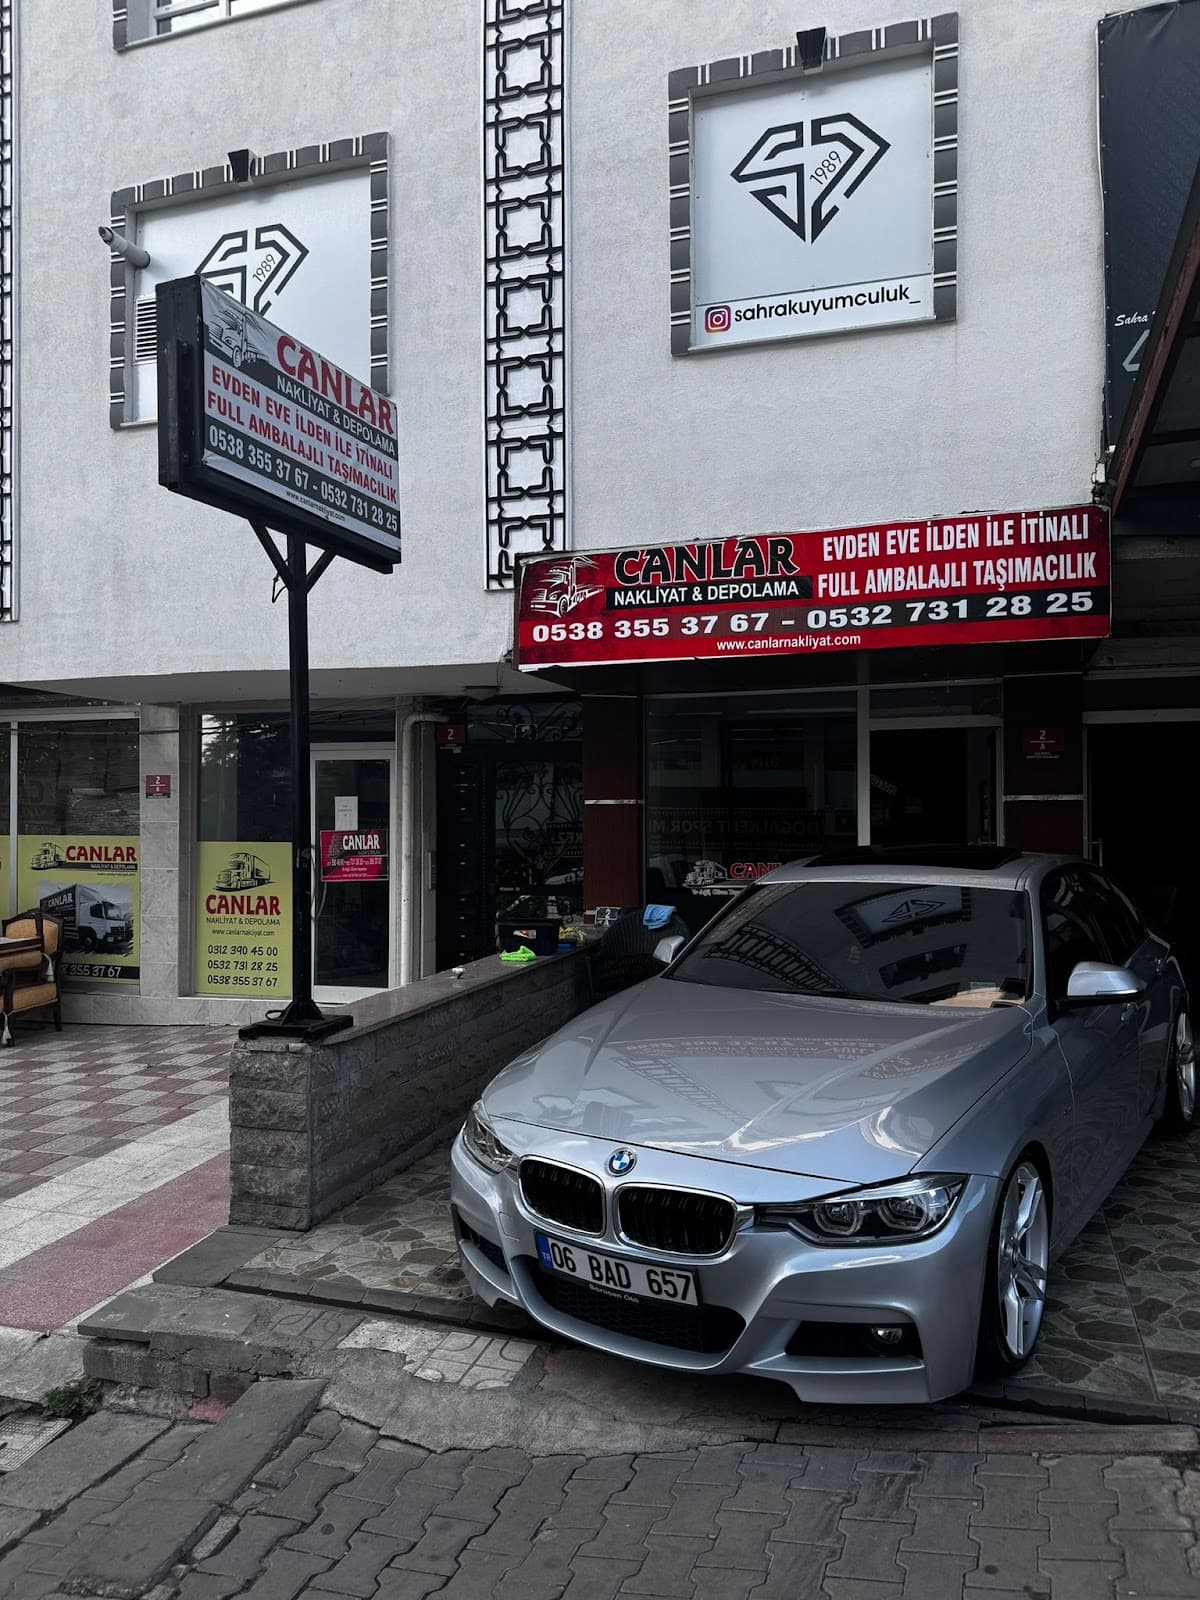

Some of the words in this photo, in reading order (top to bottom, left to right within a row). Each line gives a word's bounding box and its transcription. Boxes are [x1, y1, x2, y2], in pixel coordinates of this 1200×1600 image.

[809, 150, 842, 185] 1989
[252, 253, 277, 282] 1989
[734, 284, 921, 322] sahrakuyumculuk_
[1114, 312, 1149, 327] Sahra
[276, 335, 394, 434] CANLAR
[212, 364, 260, 408] EVDEN
[265, 396, 291, 425] EVE
[295, 411, 331, 447] İLDEN
[335, 431, 352, 459] İLE
[276, 374, 331, 419] NAKLİYAT
[333, 408, 341, 424] &
[342, 415, 396, 456] DEPOLAMA
[207, 389, 244, 426] FULL
[248, 414, 324, 467] AMBALAJLI
[327, 455, 397, 505] TAŞIMACILIK
[209, 424, 245, 460] 0538
[248, 444, 272, 473] 355
[276, 458, 291, 481] 37
[294, 467, 310, 491] 67
[321, 481, 348, 509] 0532
[350, 494, 368, 519] 731
[371, 505, 384, 525] 28
[385, 512, 398, 532] 25
[823, 532, 880, 562] EVDEN
[886, 527, 920, 556] EVE
[926, 521, 980, 552] İLDEN
[985, 515, 1014, 547] İLE
[1021, 511, 1090, 544] İTİNALI
[614, 537, 801, 586] CANLAR
[818, 573, 860, 598] FULL
[865, 561, 967, 594] AMBALAJLI
[973, 552, 1097, 592] TAŞIMACILIK
[614, 586, 688, 606] NAKLİYAT
[692, 586, 703, 601] &
[707, 581, 799, 600] DEPOLAMA
[532, 622, 603, 642] 0538
[614, 618, 670, 639] 355
[681, 615, 719, 635] 37
[730, 612, 769, 632] 67
[807, 605, 894, 630] 0532
[905, 599, 969, 622] 731
[986, 595, 1033, 617] 28
[1046, 591, 1094, 614] 25
[717, 633, 861, 651] www.canlarnakliyat.com
[447, 729, 454, 740] 2
[1040, 730, 1046, 740] 2
[65, 846, 137, 862] CANLAR
[343, 835, 380, 850] CANLAR
[48, 893, 73, 908] CANLAR
[205, 894, 282, 916] CANLAR
[206, 917, 237, 925] NAKLİYAT
[245, 918, 281, 926] DEPOLAMA
[207, 944, 228, 955] 0312
[230, 945, 248, 956] 390
[251, 946, 264, 956] 45
[266, 947, 278, 956] 00
[69, 964, 90, 976] 355
[91, 966, 105, 977] 37
[107, 966, 122, 977] 67
[207, 960, 231, 970] 0532
[233, 960, 248, 970] 731
[251, 961, 263, 971] 28
[266, 962, 278, 972] 25
[207, 975, 231, 985] 0538
[232, 976, 250, 986] 355
[252, 976, 264, 987] 37
[266, 977, 278, 987] 67
[542, 1252, 551, 1262] TR
[551, 1243, 576, 1273] 06
[587, 1254, 632, 1290] BAD
[646, 1269, 691, 1301] 657
